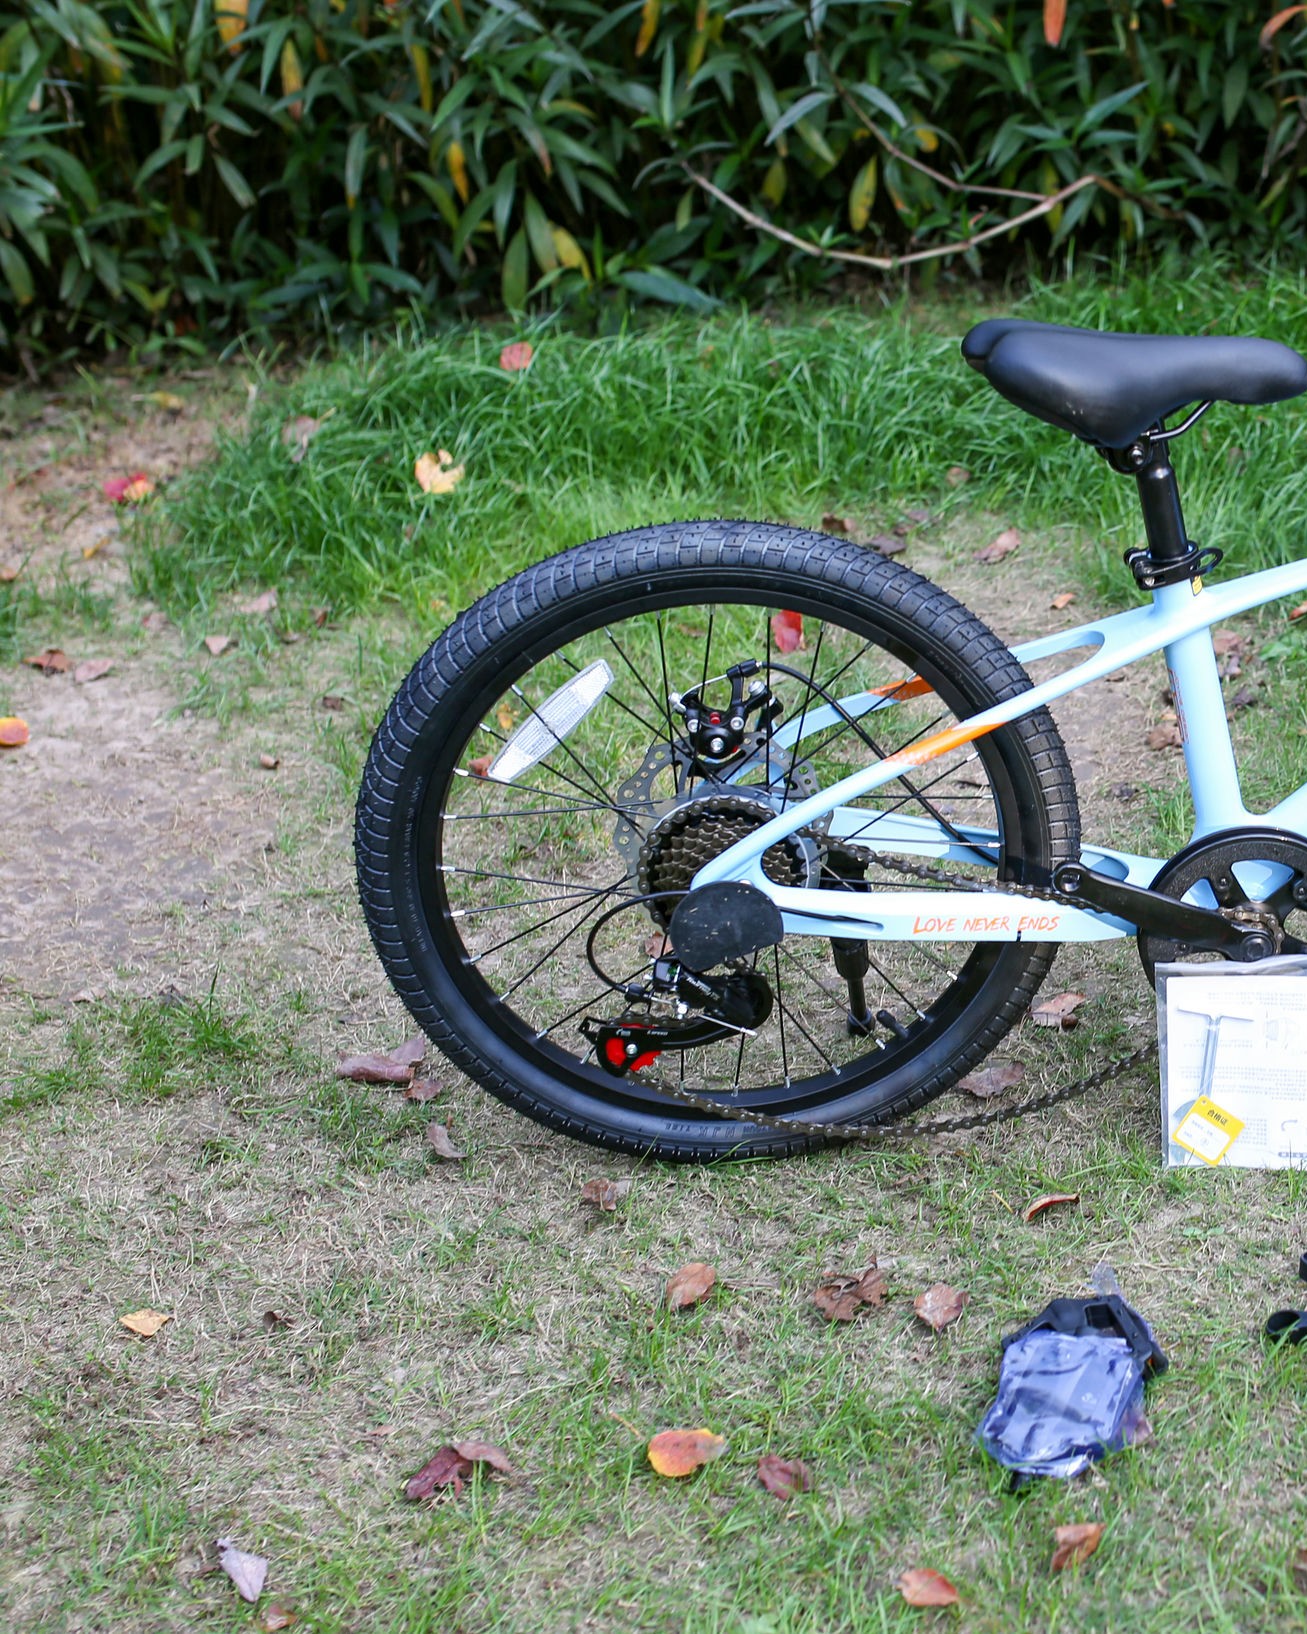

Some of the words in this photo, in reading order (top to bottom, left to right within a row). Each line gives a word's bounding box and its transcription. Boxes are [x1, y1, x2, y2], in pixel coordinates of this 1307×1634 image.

[913, 916, 957, 934] LOVE
[963, 916, 1010, 931] NEVER
[1017, 915, 1060, 931] ENDS
